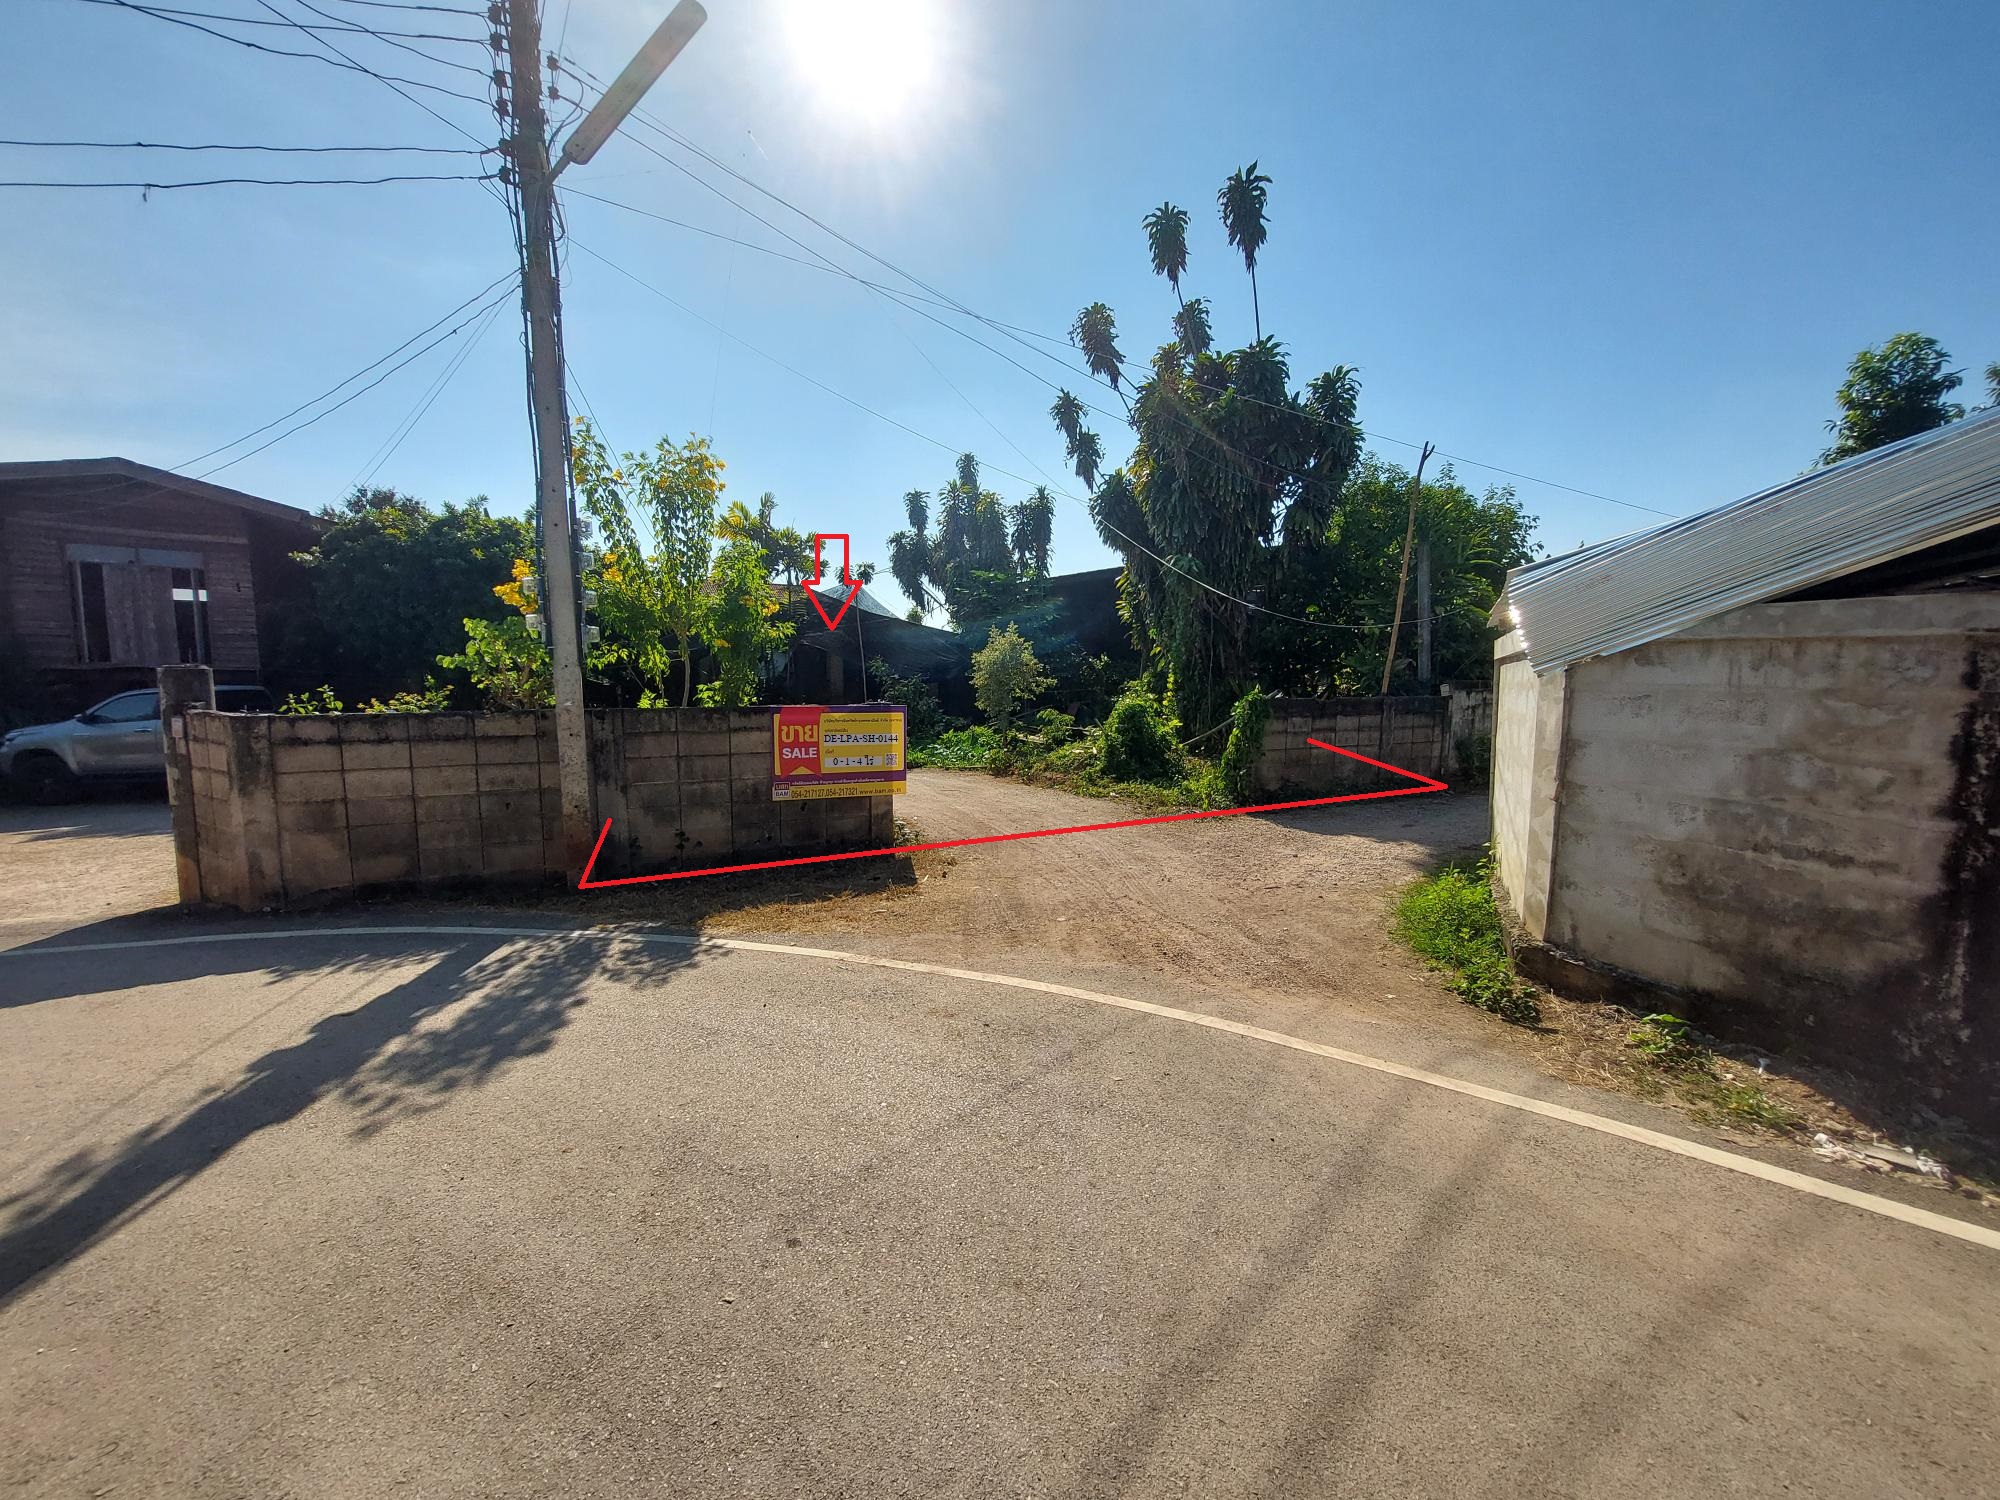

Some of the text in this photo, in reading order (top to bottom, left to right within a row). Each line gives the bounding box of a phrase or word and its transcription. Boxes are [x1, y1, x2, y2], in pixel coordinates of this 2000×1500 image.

[781, 725, 818, 742] ขาย
[823, 734, 899, 743] DE-LPA-SH-0144
[782, 747, 818, 759] SALE
